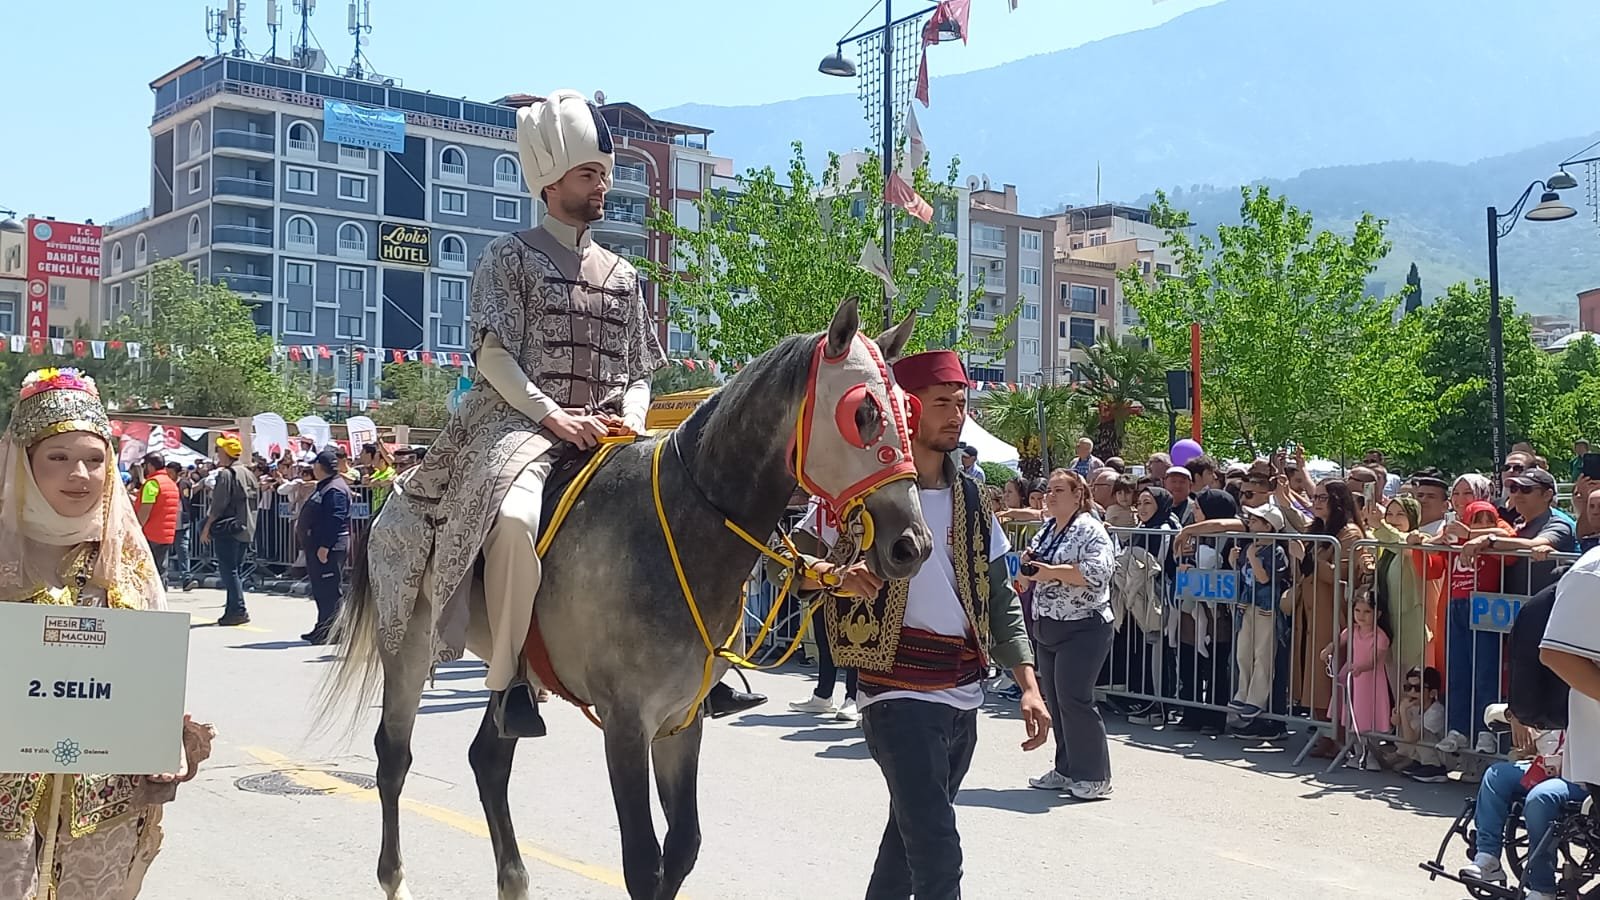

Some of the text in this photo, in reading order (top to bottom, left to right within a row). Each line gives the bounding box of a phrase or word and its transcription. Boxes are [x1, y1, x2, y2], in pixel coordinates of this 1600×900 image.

[76, 227, 93, 236] T.C.
[382, 226, 428, 245] Looks
[383, 244, 428, 262] HOTEL
[37, 261, 82, 275] GENÇLİK
[61, 633, 104, 642] MACUNU
[28, 677, 112, 700] 2. SELİM
